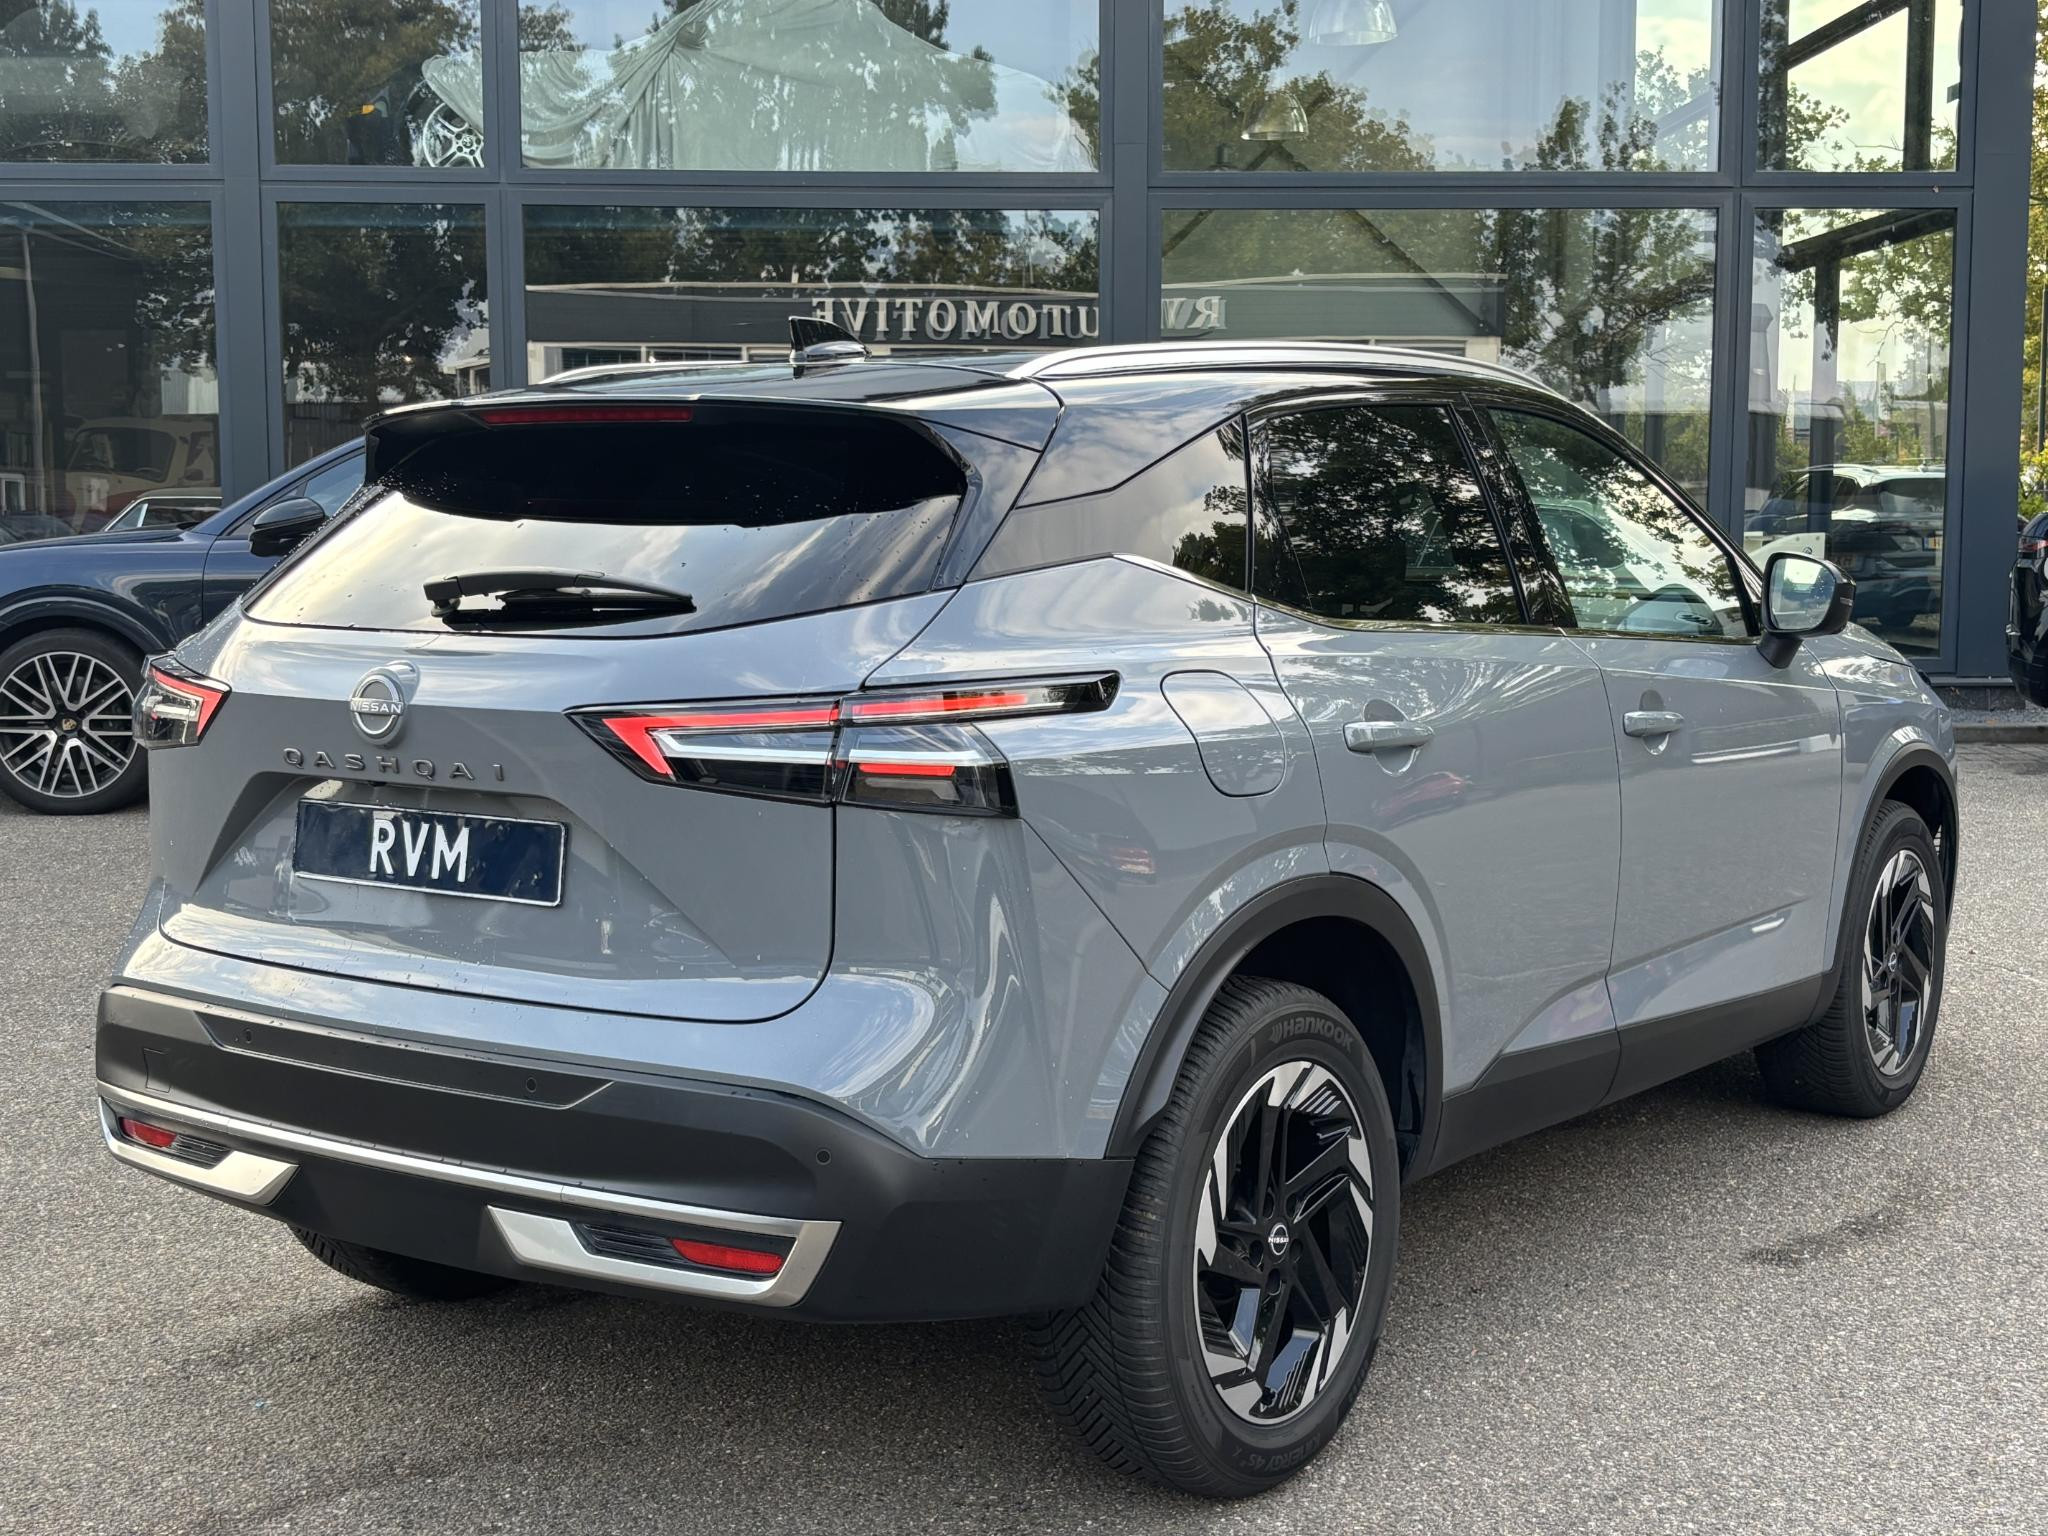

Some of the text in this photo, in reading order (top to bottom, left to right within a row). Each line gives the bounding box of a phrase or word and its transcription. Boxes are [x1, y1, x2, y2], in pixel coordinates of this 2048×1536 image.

[350, 700, 402, 713] NISSAN
[283, 747, 505, 781] QASHQAI
[369, 819, 470, 883] RVM
